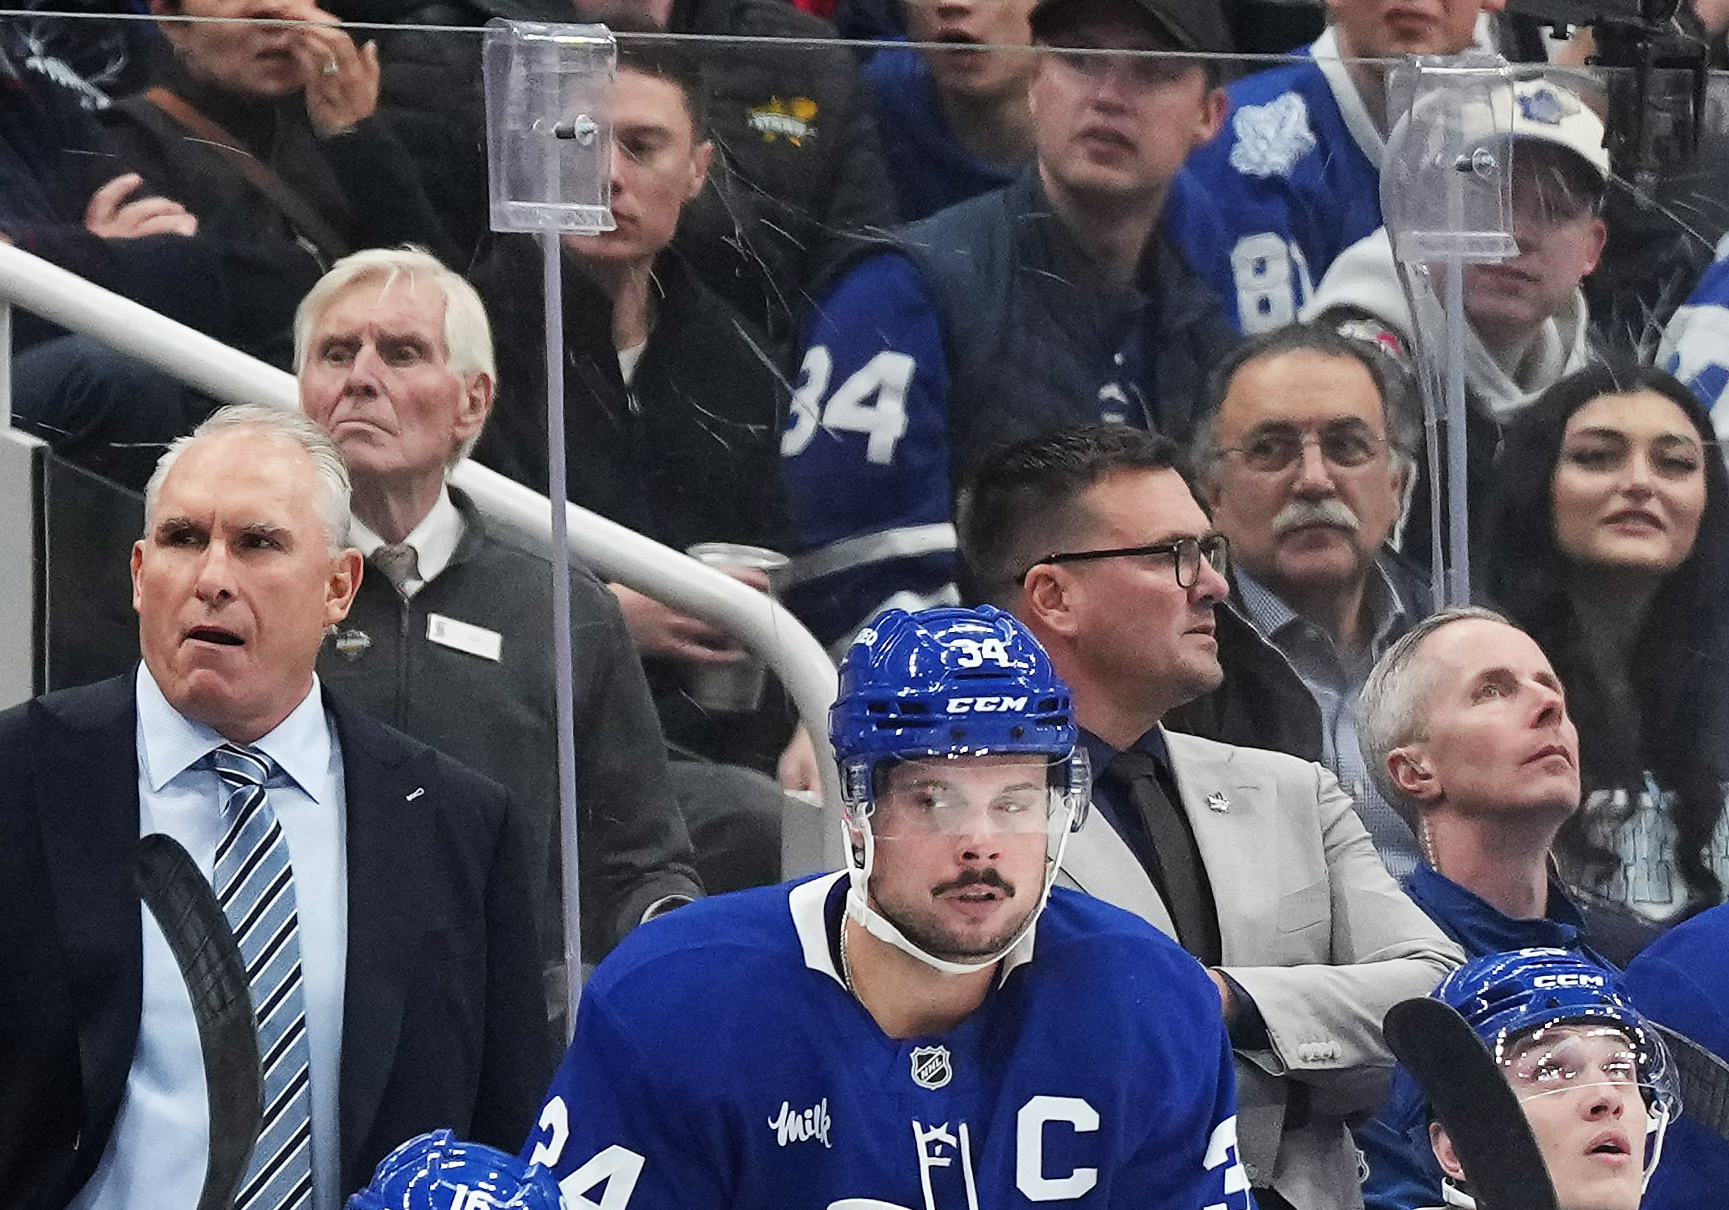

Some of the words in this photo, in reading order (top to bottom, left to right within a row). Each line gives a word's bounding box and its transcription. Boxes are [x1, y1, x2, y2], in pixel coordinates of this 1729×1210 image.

[779, 346, 917, 465] 34
[948, 638, 1014, 669] 34
[946, 696, 1029, 714] CCM
[1533, 973, 1605, 989] CCM
[920, 1054, 945, 1081] NHL
[767, 1097, 833, 1150] Milk
[1016, 1095, 1101, 1203] C
